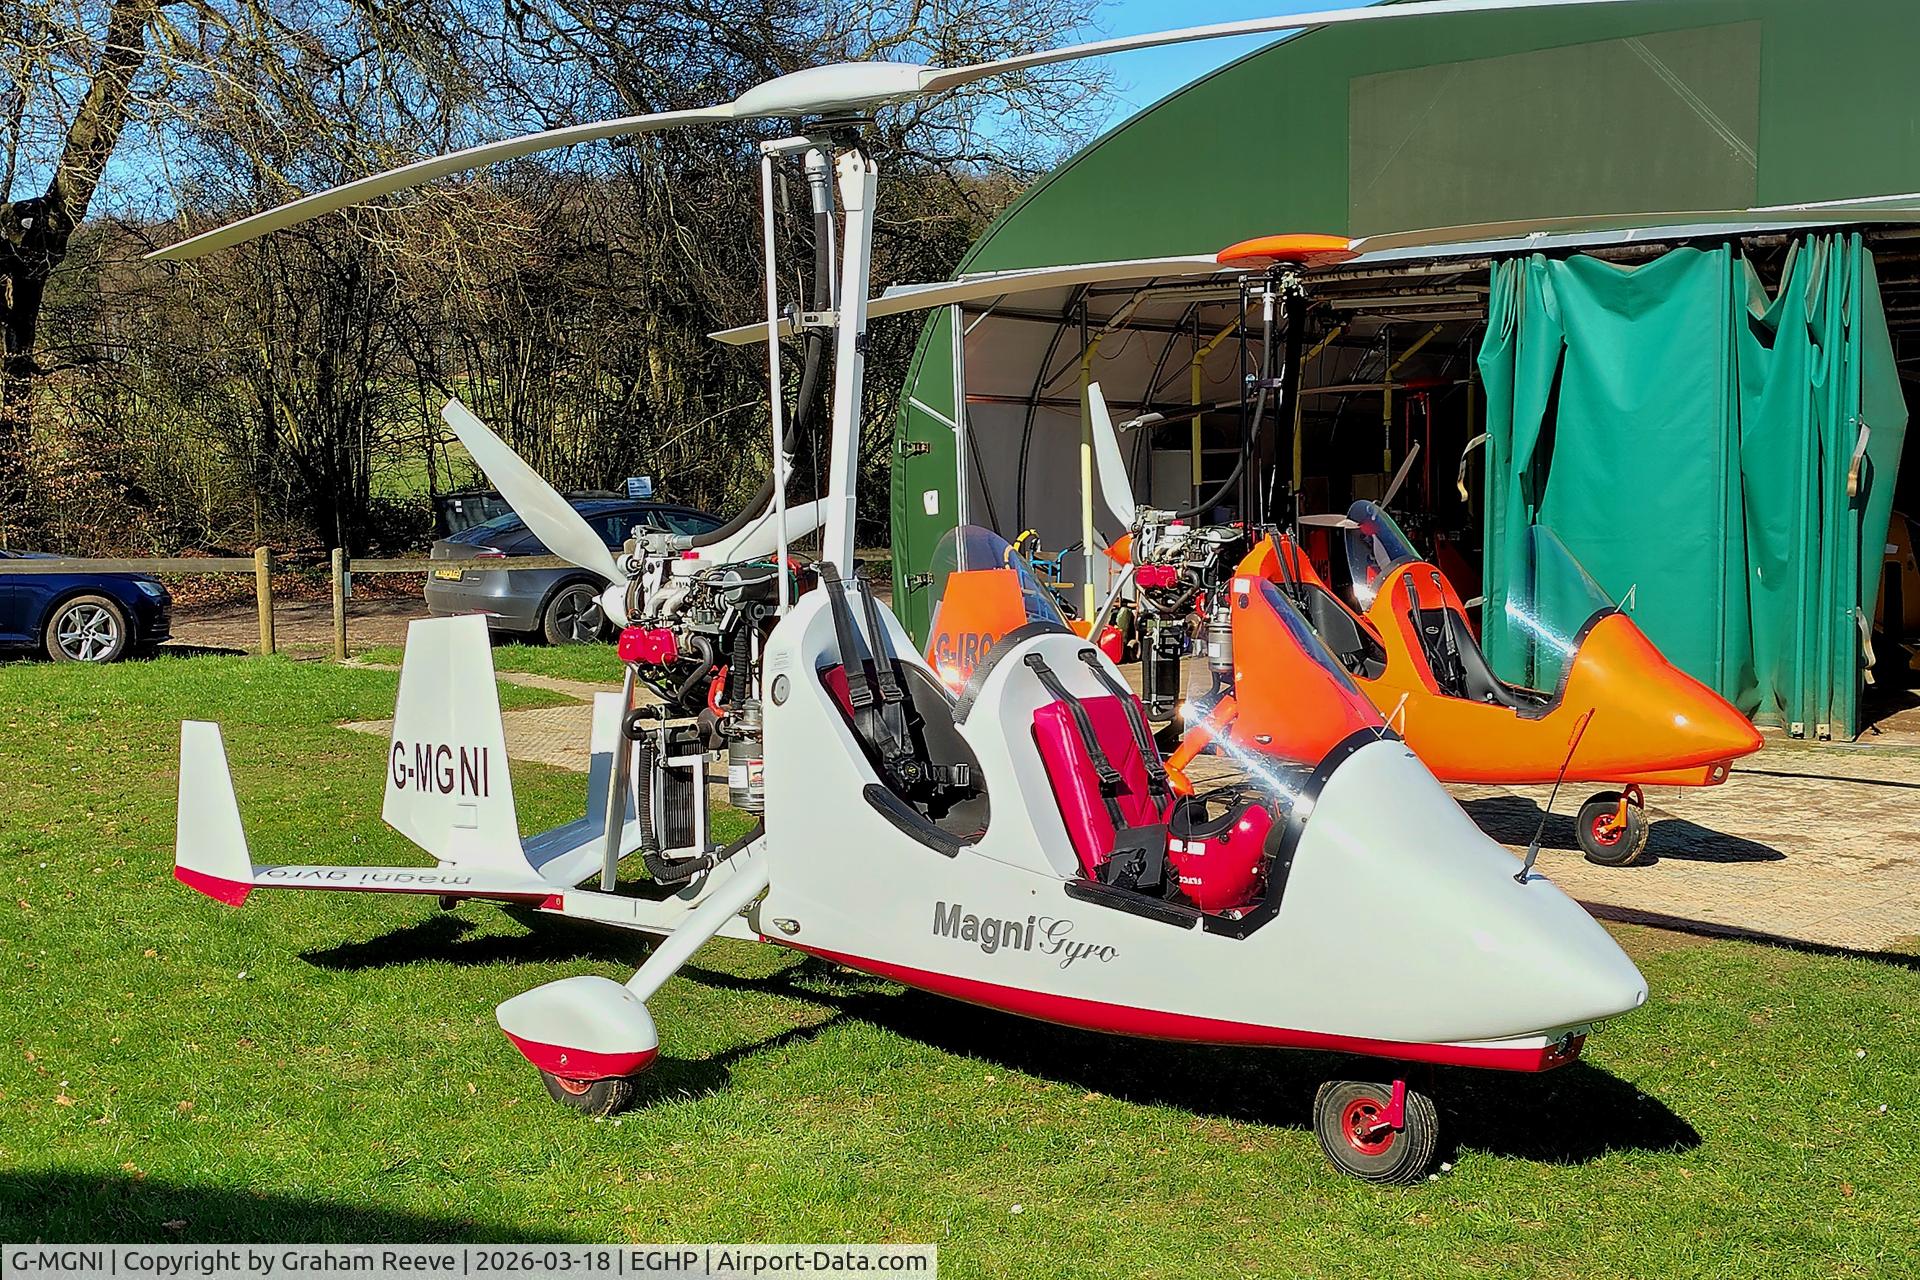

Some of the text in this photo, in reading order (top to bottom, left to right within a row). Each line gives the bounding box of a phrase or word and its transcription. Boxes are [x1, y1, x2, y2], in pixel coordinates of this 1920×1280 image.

[935, 632, 1008, 671] G-IRO
[392, 740, 489, 797] G-MGNI
[266, 869, 472, 885] magni gyro
[933, 901, 1120, 970] Magni Gyro
